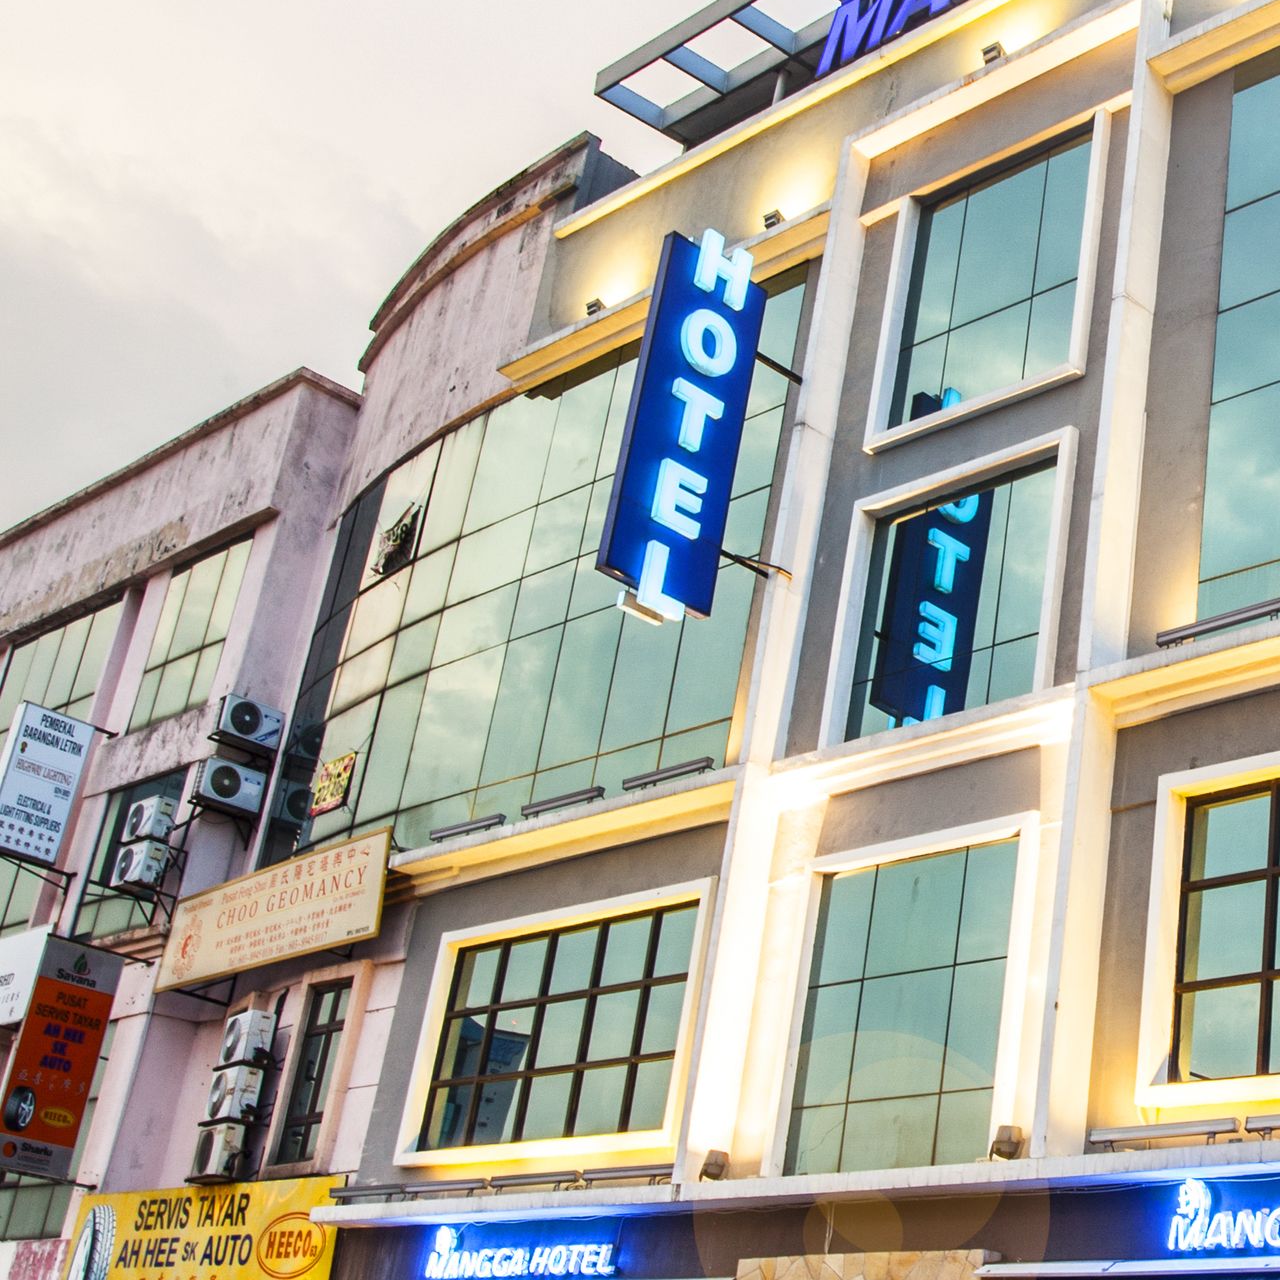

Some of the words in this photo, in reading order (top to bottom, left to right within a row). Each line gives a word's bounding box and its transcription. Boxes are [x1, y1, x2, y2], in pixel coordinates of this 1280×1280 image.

[637, 228, 755, 622] HOTEL
[40, 713, 76, 738] PEMBEKAL
[22, 724, 60, 751] BARANGAN
[59, 738, 84, 757] LETRIK
[42, 766, 73, 786] LIGHTING
[17, 794, 47, 814] ELECTRICAL
[15, 809, 34, 826] FITTING
[34, 814, 62, 834] SUPPLIERS
[216, 900, 258, 929] CHOO
[266, 865, 369, 913] GEOMANCY
[56, 968, 97, 989] Savana
[56, 992, 88, 1009] PUSAT
[35, 1003, 70, 1023] SERVIS
[71, 1012, 102, 1030] TAYAR
[63, 1026, 85, 1044] HEE
[40, 1055, 72, 1072] AUTO
[134, 1196, 193, 1232] SERVIS
[194, 1193, 250, 1228] TAYAR
[115, 1239, 142, 1269] AH
[142, 1237, 181, 1269] HEE
[181, 1241, 198, 1262] SK
[199, 1233, 253, 1267] AUTO
[265, 1230, 310, 1259] HEECO
[425, 1225, 530, 1279] MANGGA
[529, 1243, 616, 1278] HOTEL
